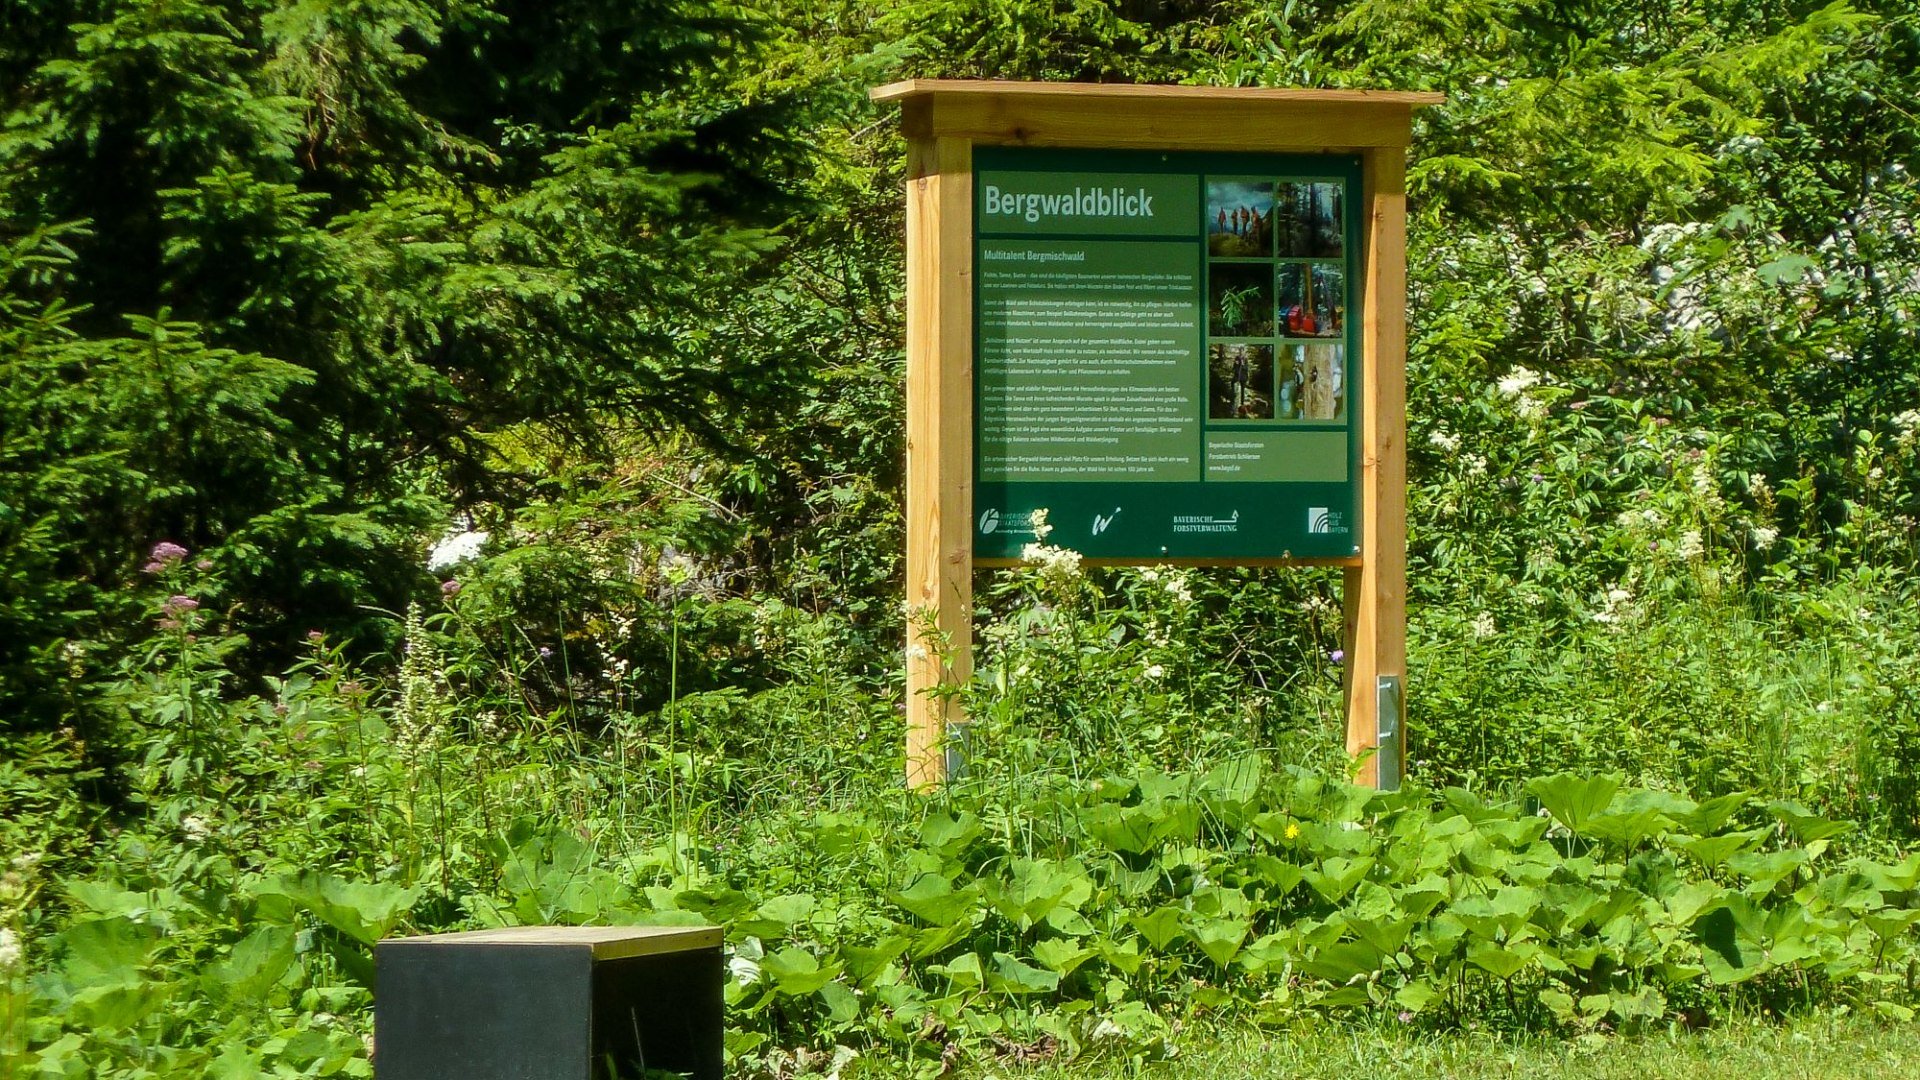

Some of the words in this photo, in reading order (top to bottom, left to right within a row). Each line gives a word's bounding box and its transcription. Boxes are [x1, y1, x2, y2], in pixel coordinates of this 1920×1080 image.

[985, 185, 1153, 222] Bergwaldblick
[984, 250, 1025, 260] Multitalent
[1027, 250, 1084, 262] Bergmischwald
[1173, 525, 1237, 533] FORSTVERWALTUNG
